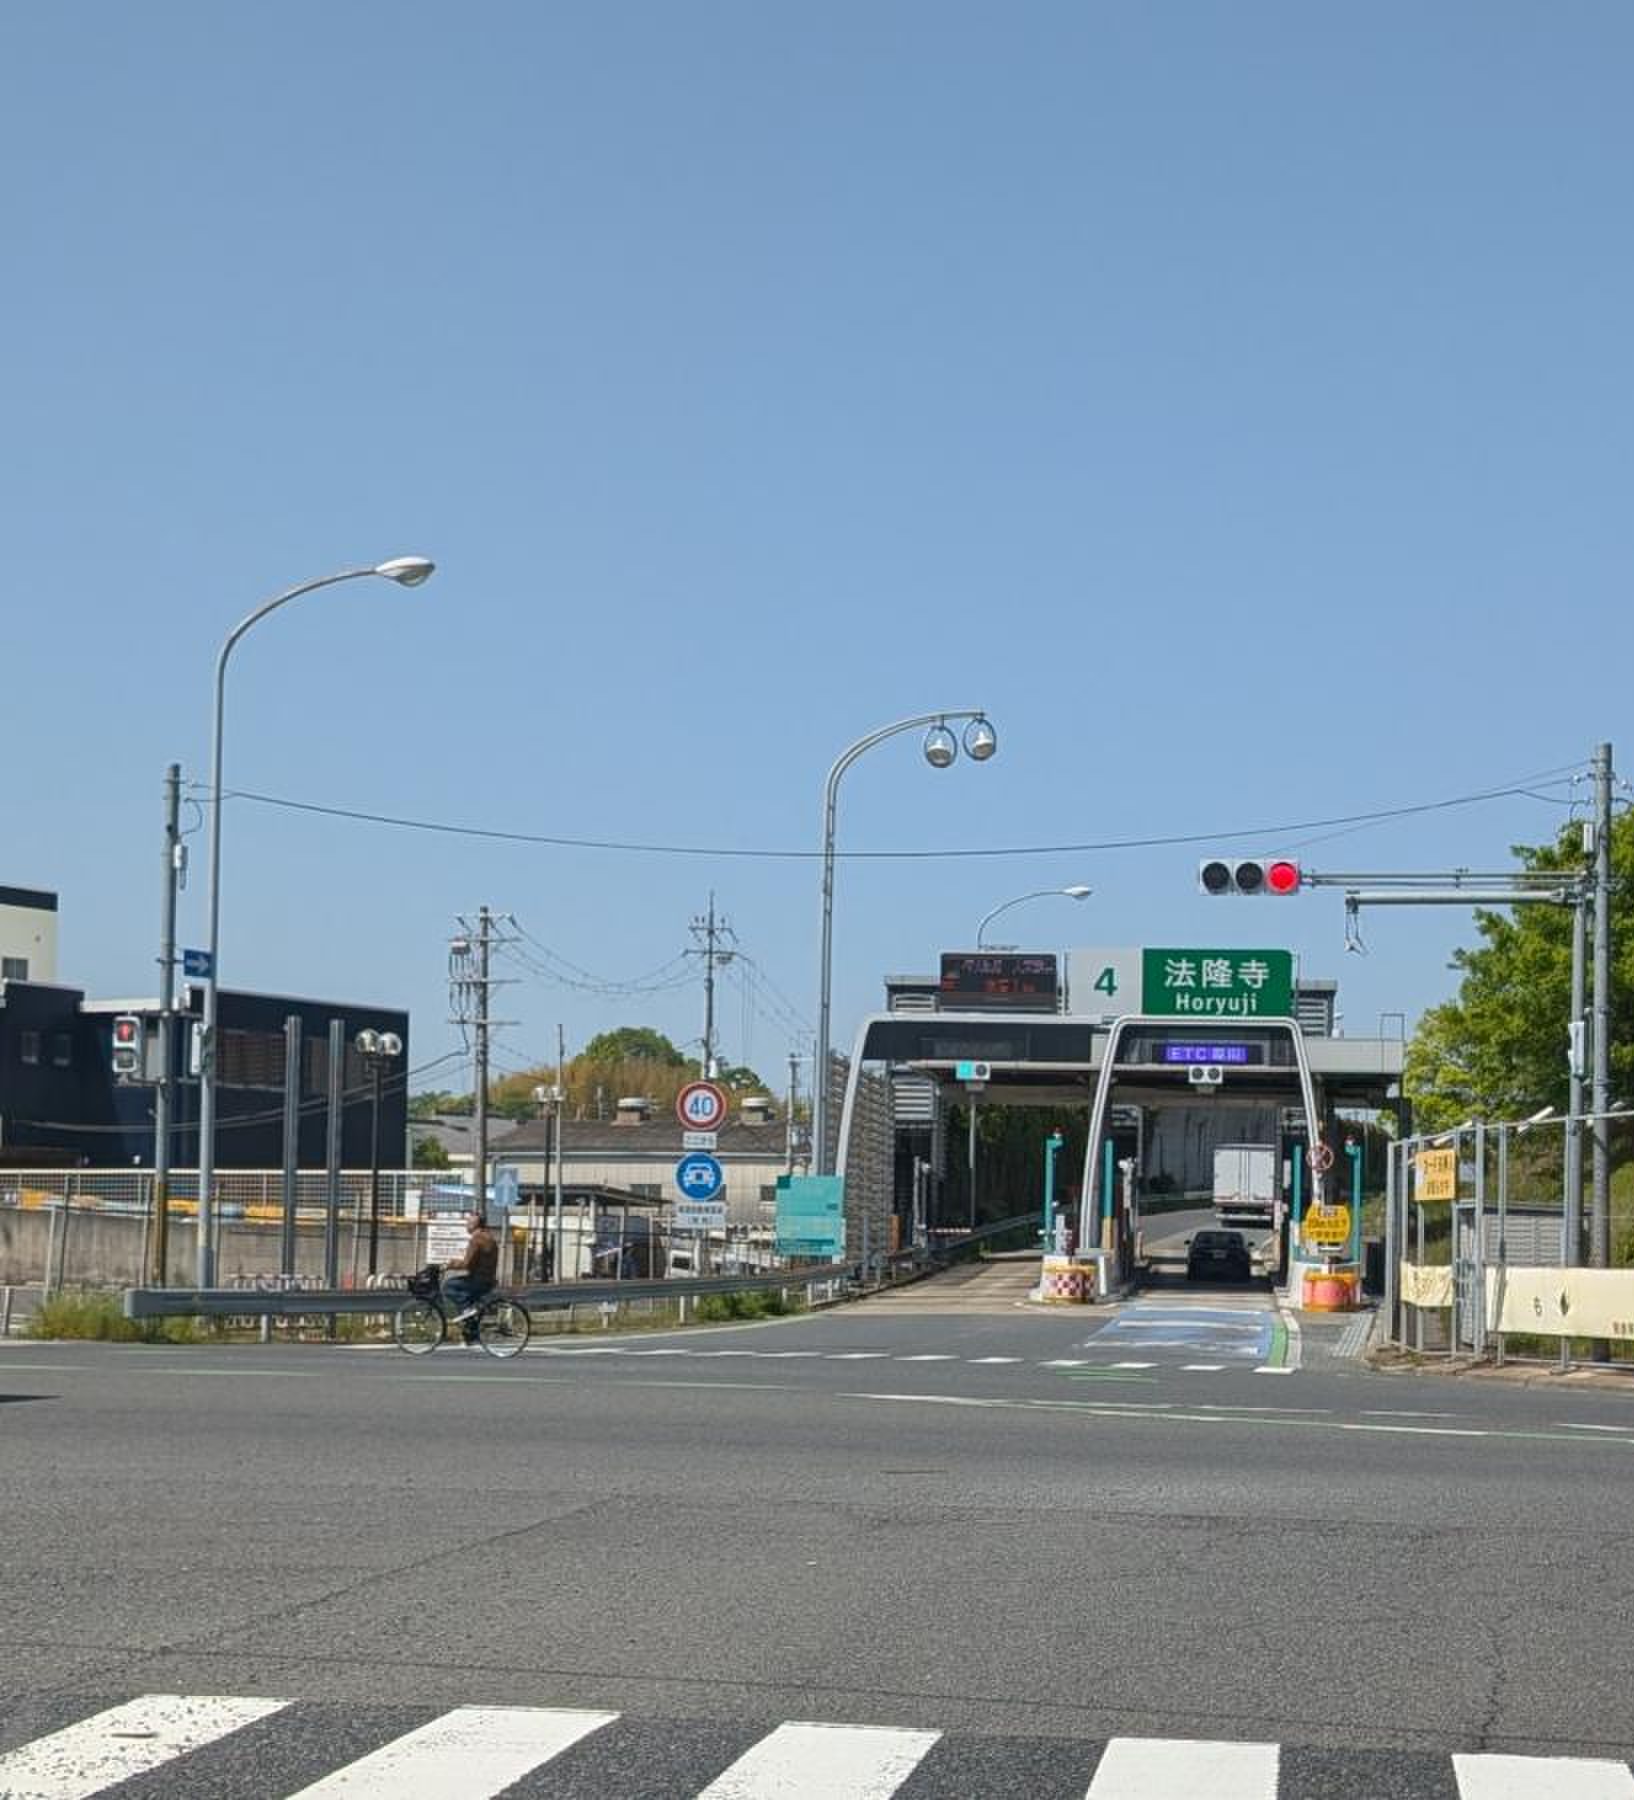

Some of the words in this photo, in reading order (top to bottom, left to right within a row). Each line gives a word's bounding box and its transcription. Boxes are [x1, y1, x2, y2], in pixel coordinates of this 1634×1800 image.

[1093, 966, 1119, 997] 4
[1163, 958, 1270, 990] 法隆寺
[1174, 993, 1258, 1016] Horyuji
[689, 1096, 714, 1116] 40
